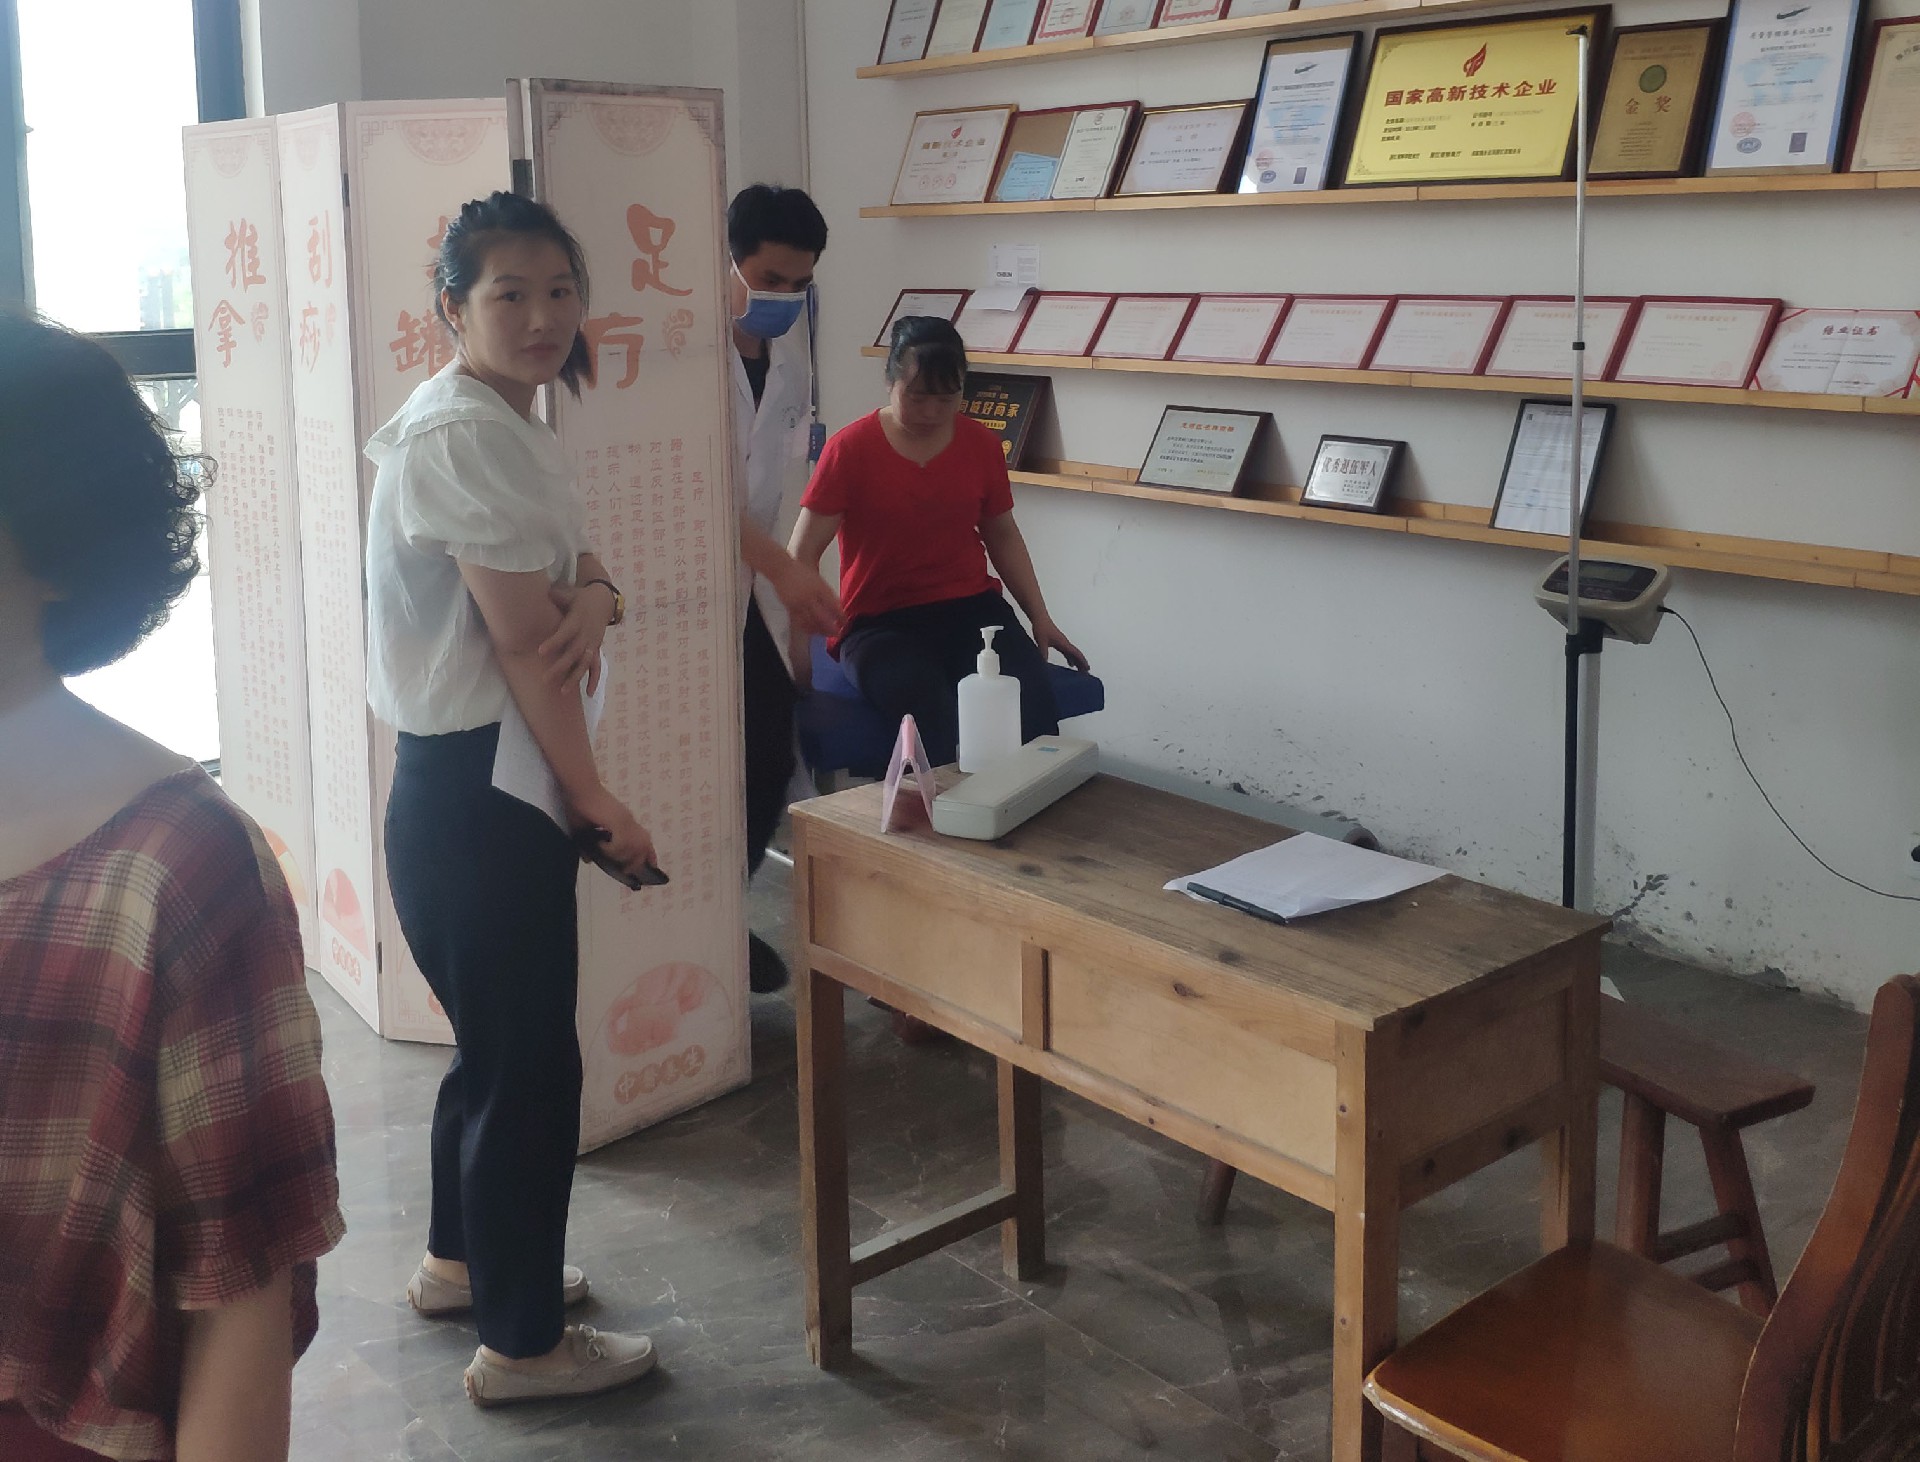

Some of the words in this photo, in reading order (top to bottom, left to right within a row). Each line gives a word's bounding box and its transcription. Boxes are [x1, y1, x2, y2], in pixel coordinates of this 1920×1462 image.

[1384, 78, 1557, 107] 国家高新技术企业
[208, 218, 267, 368] 推拿
[299, 209, 333, 374] 刮痧
[1321, 457, 1377, 476] 优秀退伍军人
